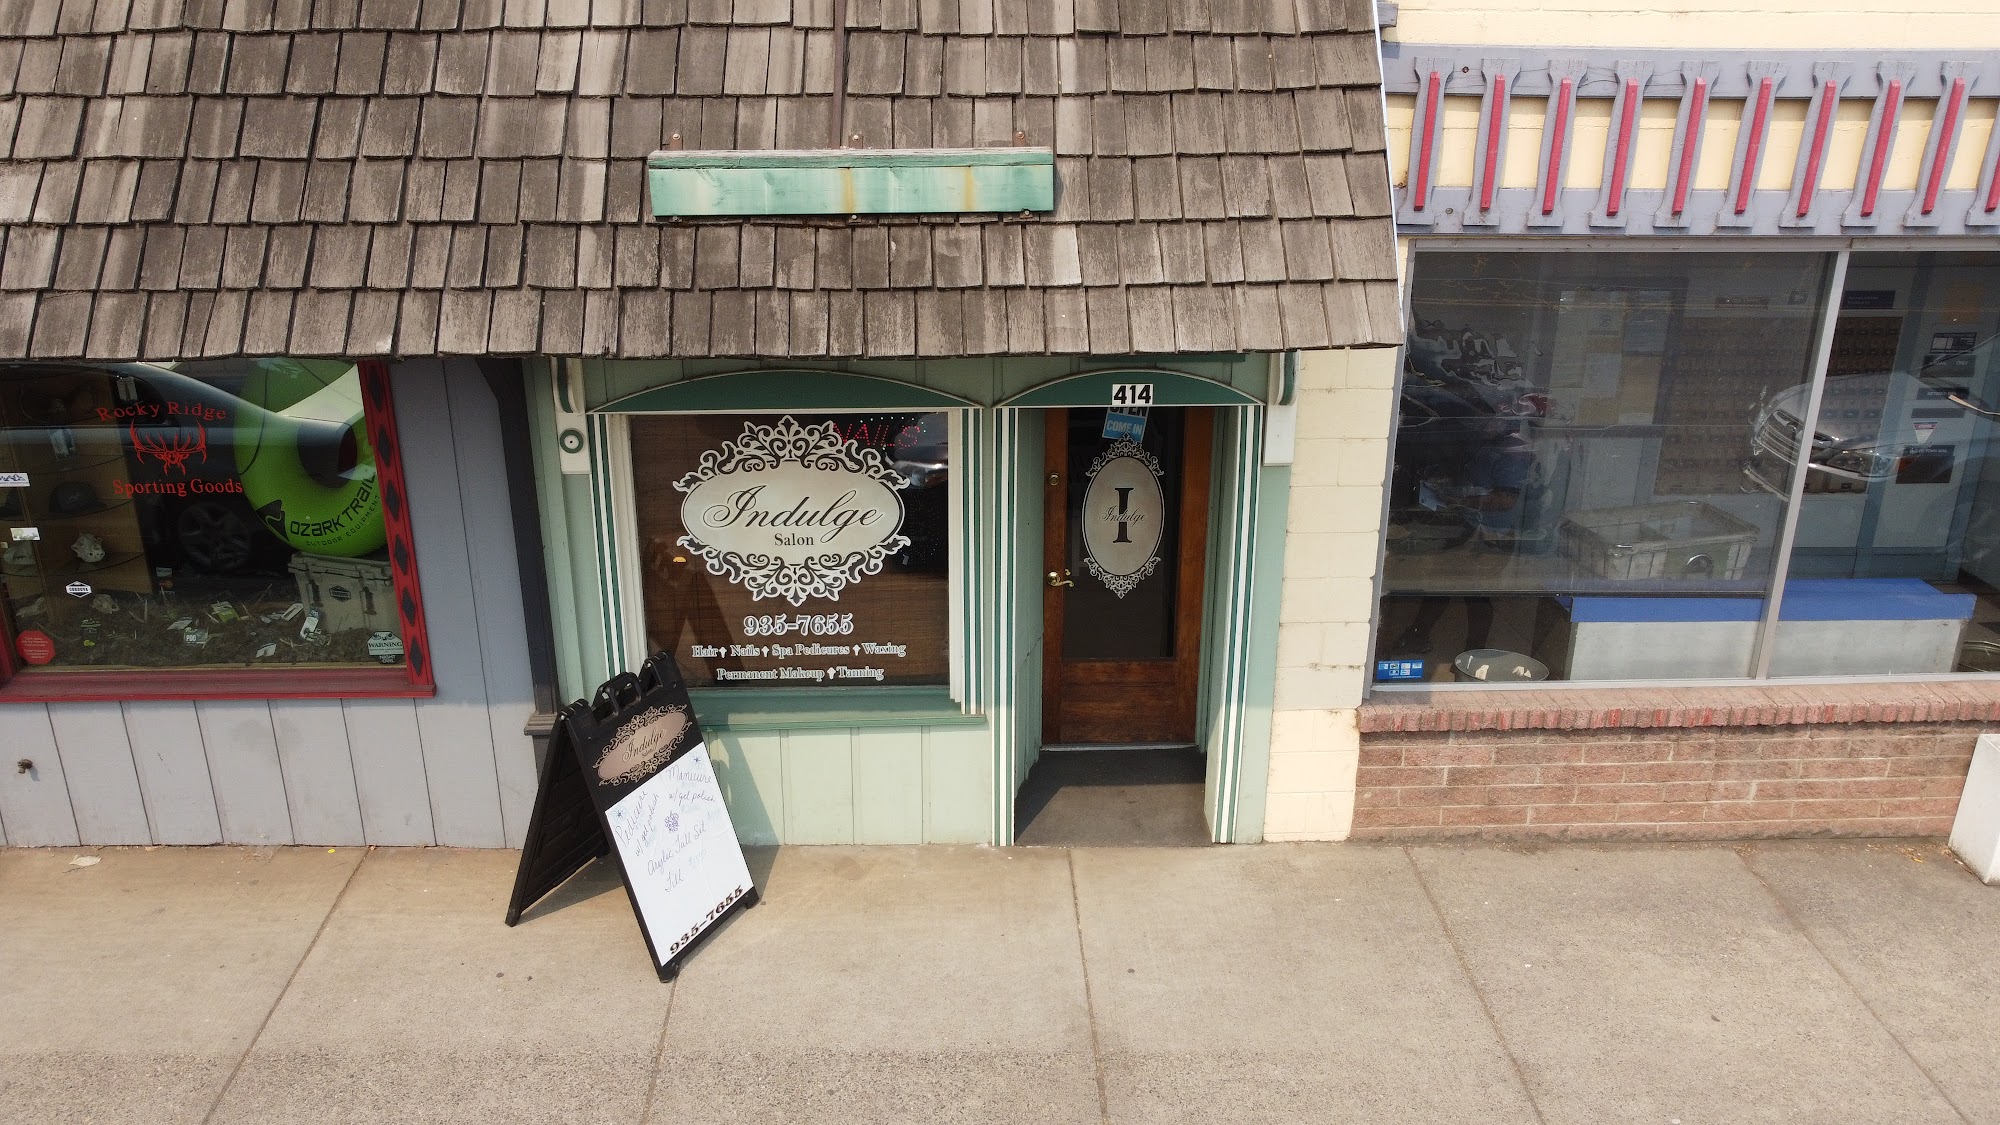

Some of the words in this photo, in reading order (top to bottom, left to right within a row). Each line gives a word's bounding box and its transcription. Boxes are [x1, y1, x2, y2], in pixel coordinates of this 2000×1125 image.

[1113, 385, 1151, 404] 414
[96, 402, 160, 421] Rocky
[166, 401, 227, 420] Ridge
[833, 423, 921, 448] NAILS
[1107, 420, 1132, 432] COME
[1132, 423, 1143, 435] IN
[113, 479, 188, 499] Sporting
[190, 478, 244, 494] Goods
[306, 535, 343, 546] OUTDOOR
[345, 493, 381, 537] EQUIPMENT
[702, 485, 884, 544] Indulge
[1100, 506, 1146, 527] Indulge
[290, 516, 345, 537] OZARK
[774, 532, 815, 546] Salon
[743, 612, 854, 636] 935-7655
[692, 645, 719, 658] Hair
[730, 644, 760, 658] Nails
[771, 643, 793, 659] Spa
[795, 643, 850, 656] Pedicures
[861, 642, 906, 658] Waxing
[717, 667, 778, 681] Permanent
[779, 667, 825, 681] Makeup
[836, 666, 885, 681] Tanning
[621, 729, 667, 763] Indulge
[666, 765, 713, 785] Manicure
[615, 790, 648, 848] Pedicure
[693, 822, 707, 840] Set
[669, 884, 743, 955] 935-7655
